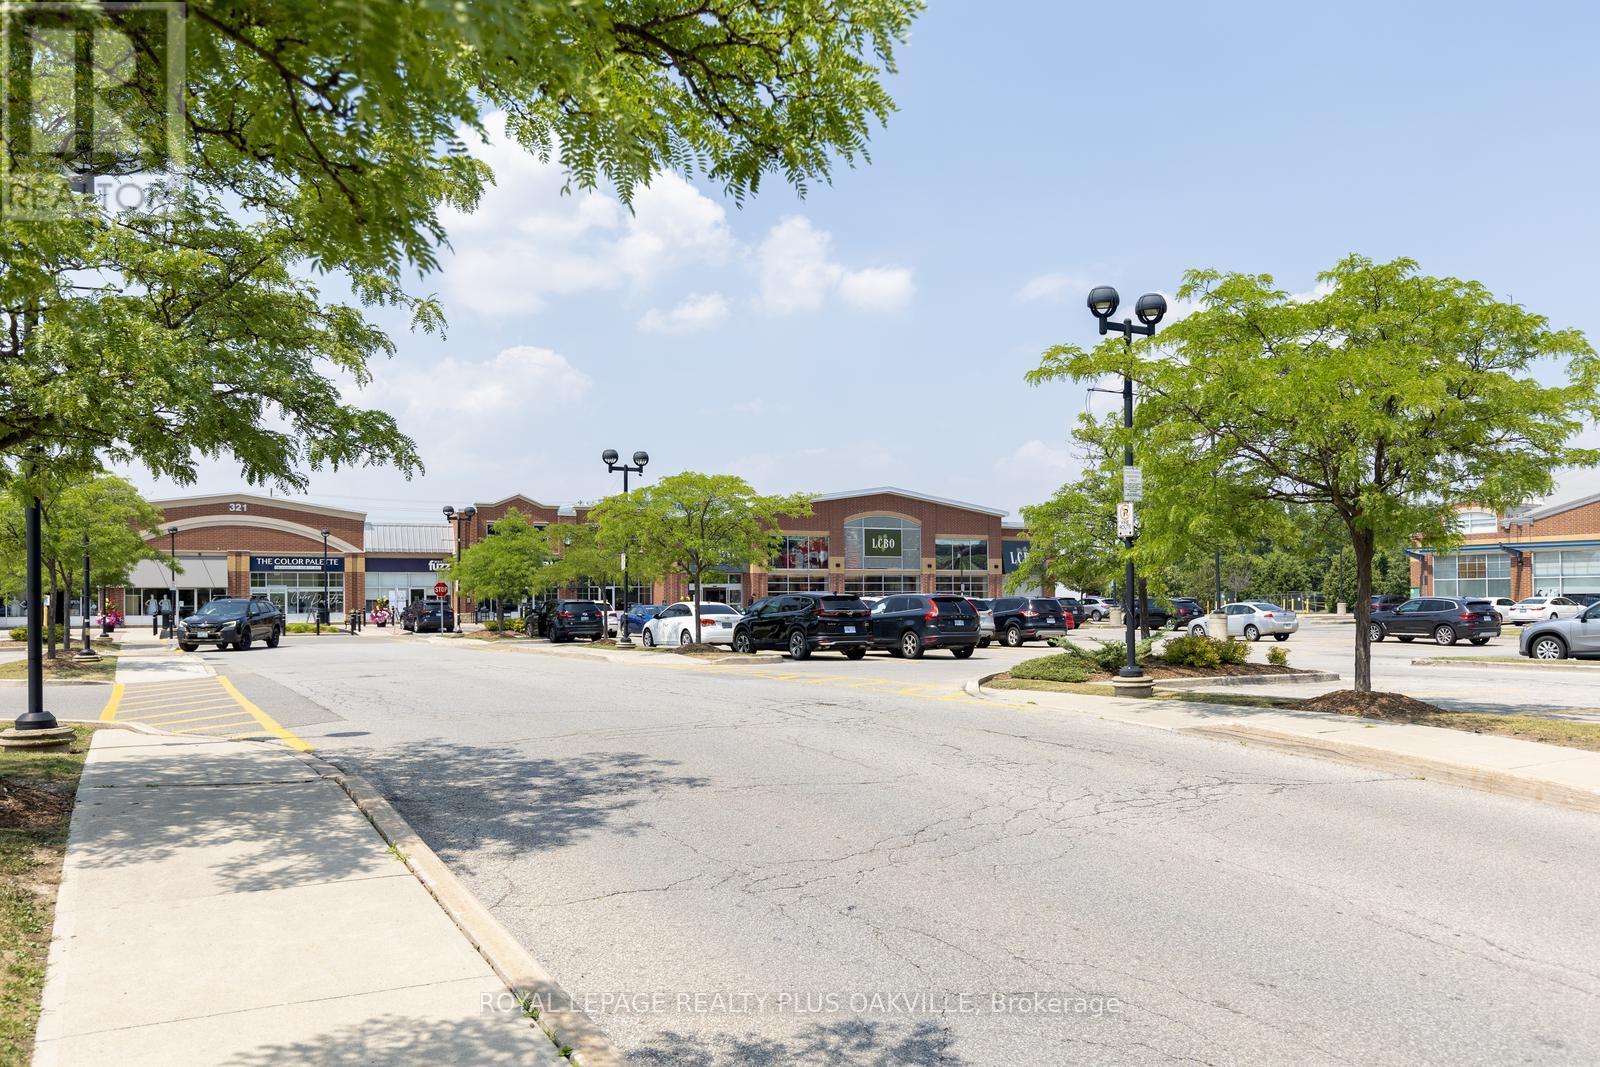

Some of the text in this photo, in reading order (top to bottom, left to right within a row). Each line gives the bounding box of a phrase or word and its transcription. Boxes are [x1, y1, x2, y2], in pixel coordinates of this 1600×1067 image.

[229, 503, 247, 511] 321
[872, 538, 895, 549] LCBO
[305, 558, 339, 566] PALETE
